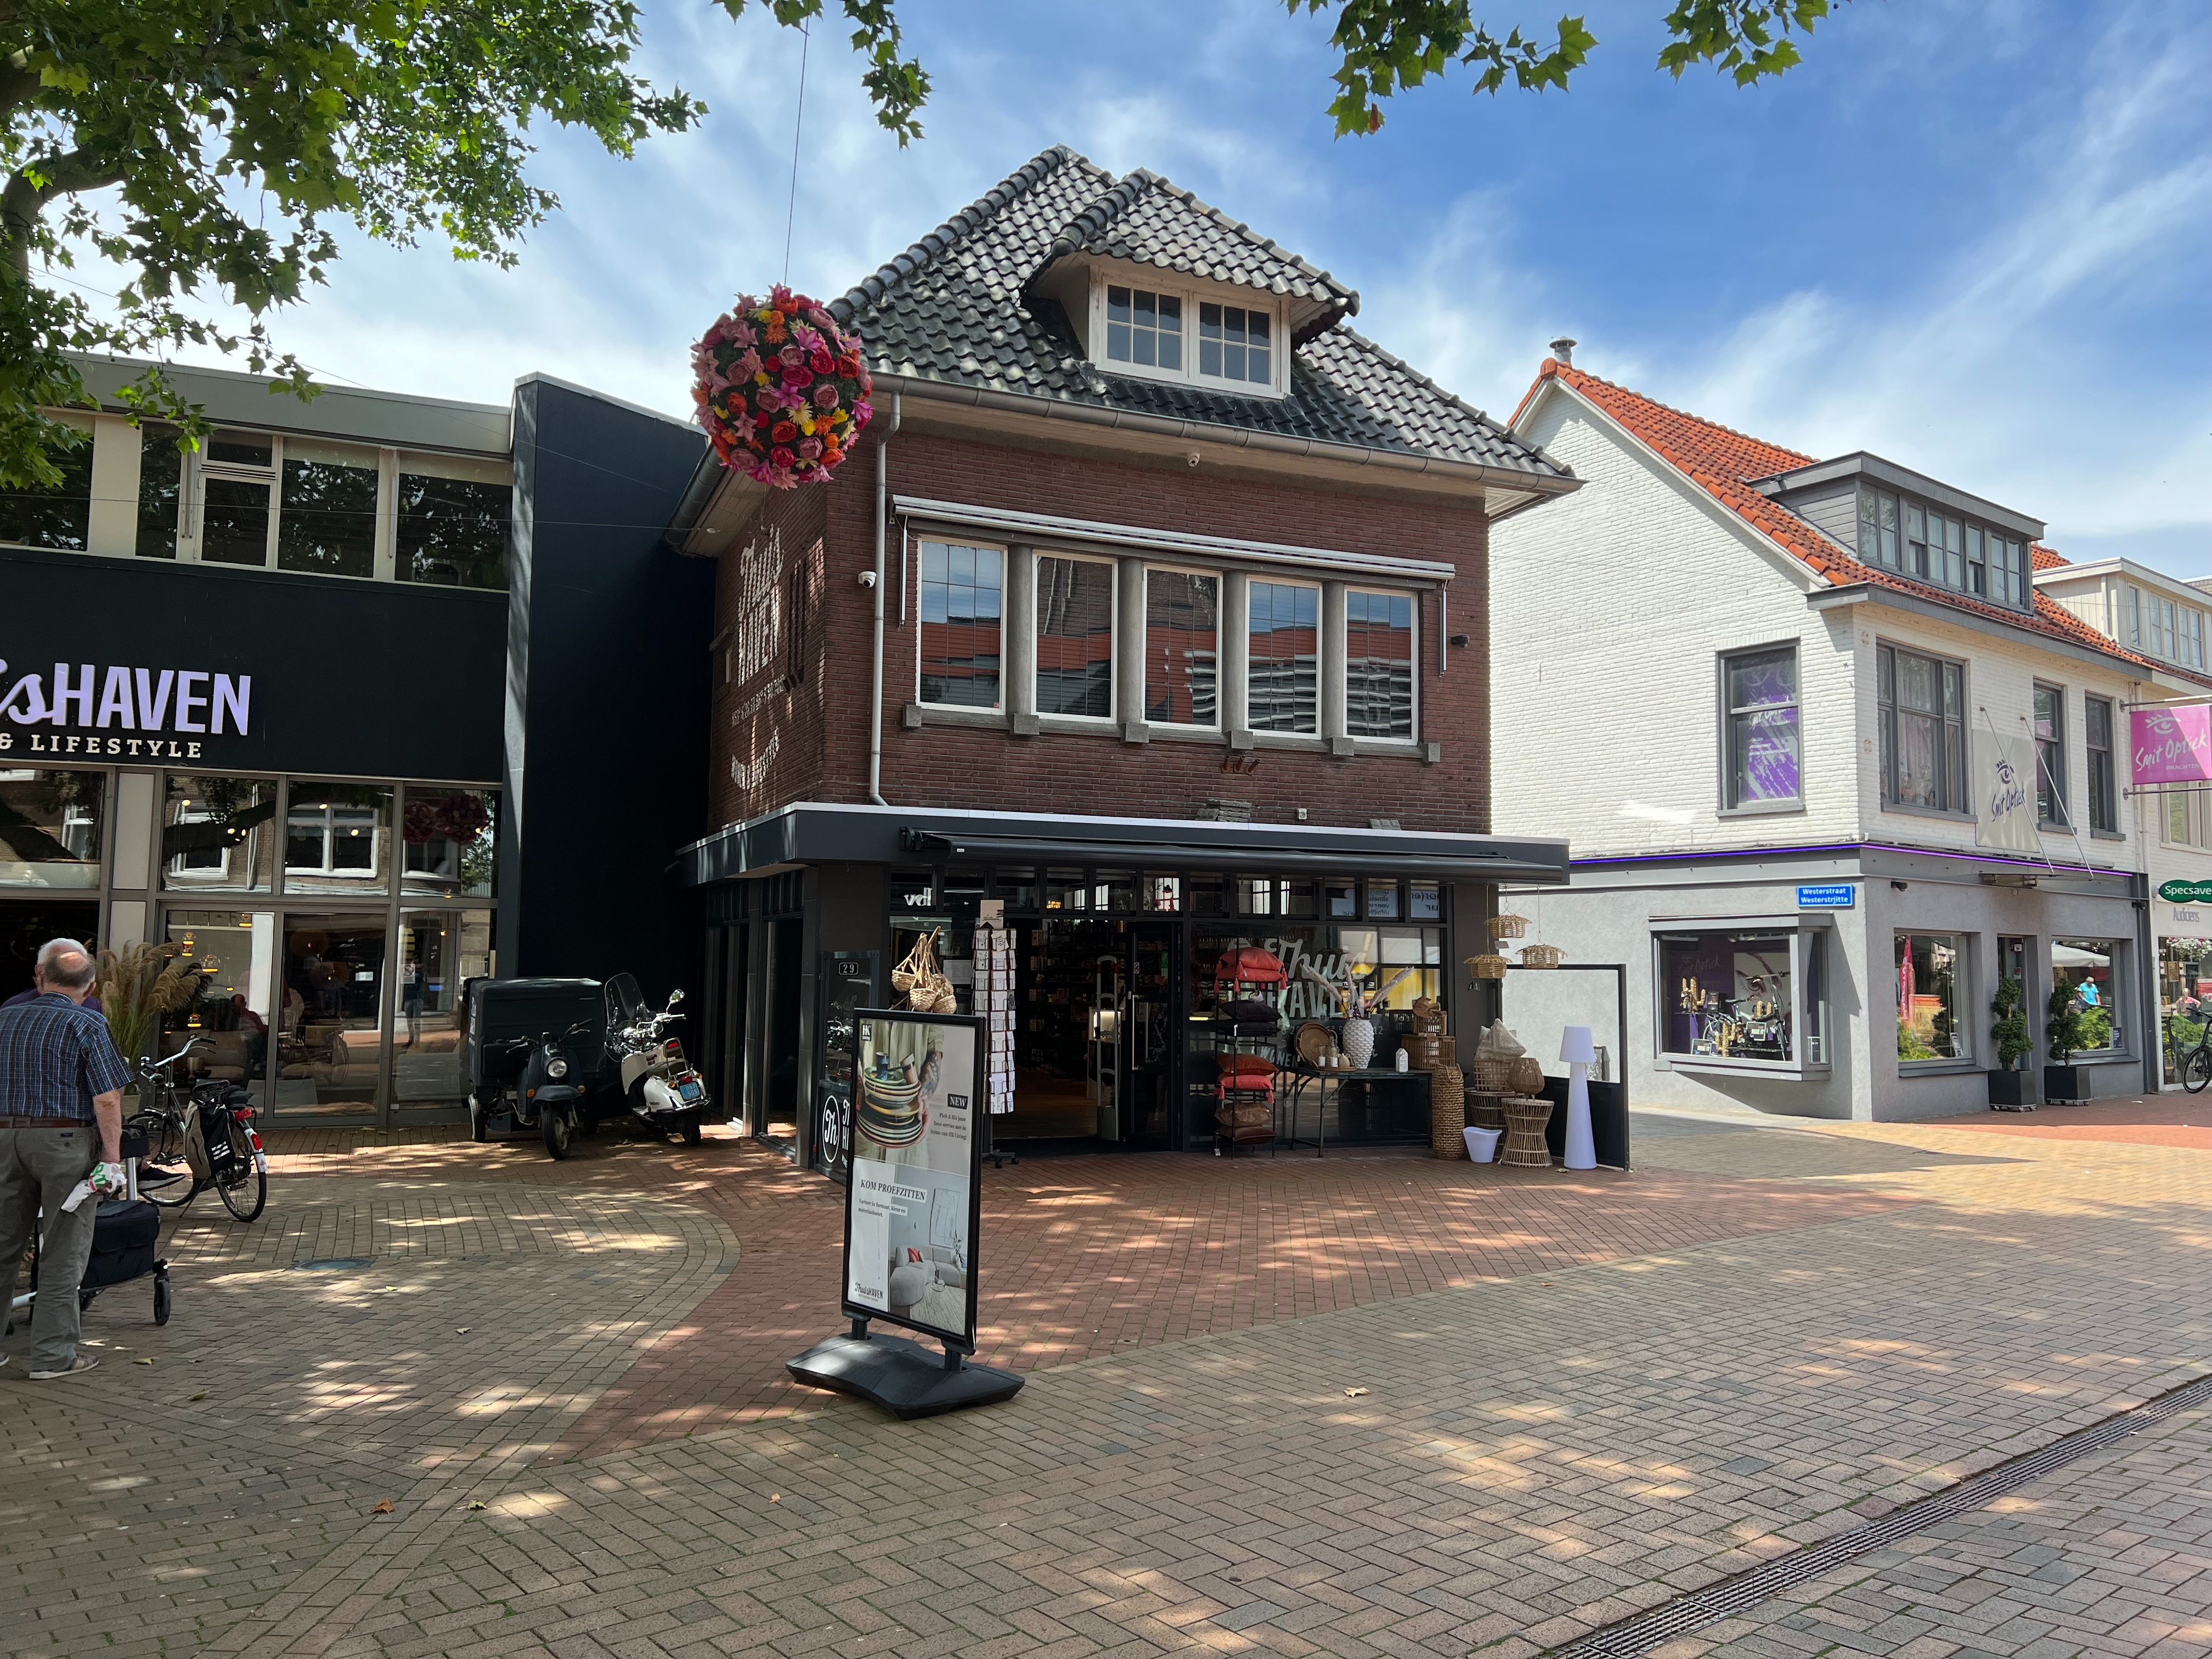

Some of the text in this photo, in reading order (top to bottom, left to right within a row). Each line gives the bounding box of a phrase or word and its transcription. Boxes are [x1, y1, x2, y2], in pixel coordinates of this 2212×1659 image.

[0, 659, 251, 736] sHAVEN
[31, 735, 201, 758] LIFESTYLE
[2136, 728, 2208, 772] Smit Optiek
[1801, 896, 1848, 904] Westerstrjitte
[843, 964, 854, 974] 29
[950, 1096, 967, 1107] NEW
[825, 1109, 838, 1146] Th
[861, 1179, 926, 1200] KOM PROEFZITTEN
